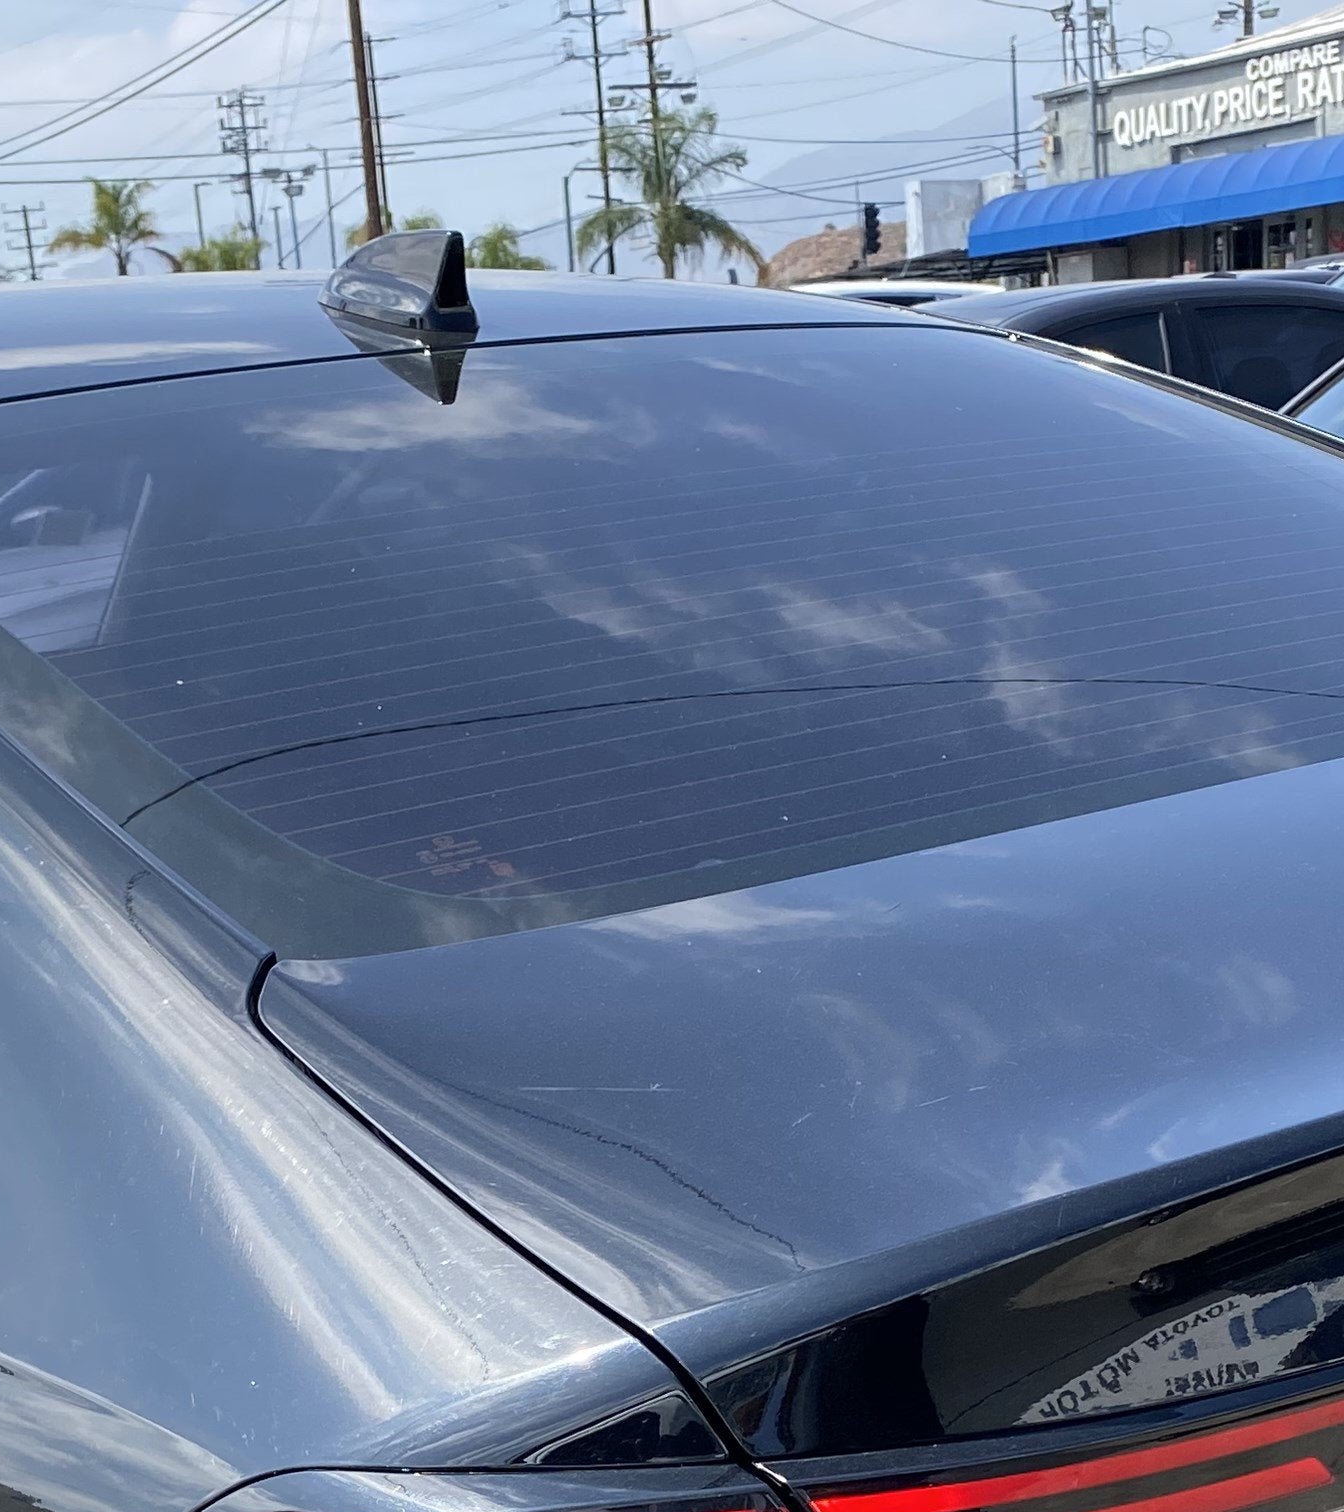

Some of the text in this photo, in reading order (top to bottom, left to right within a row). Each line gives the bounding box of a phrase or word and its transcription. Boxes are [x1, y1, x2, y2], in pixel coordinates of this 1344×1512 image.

[1246, 39, 1340, 81] COMPARE
[1113, 93, 1211, 148] QUALITY,
[1213, 78, 1291, 127] PRICE,
